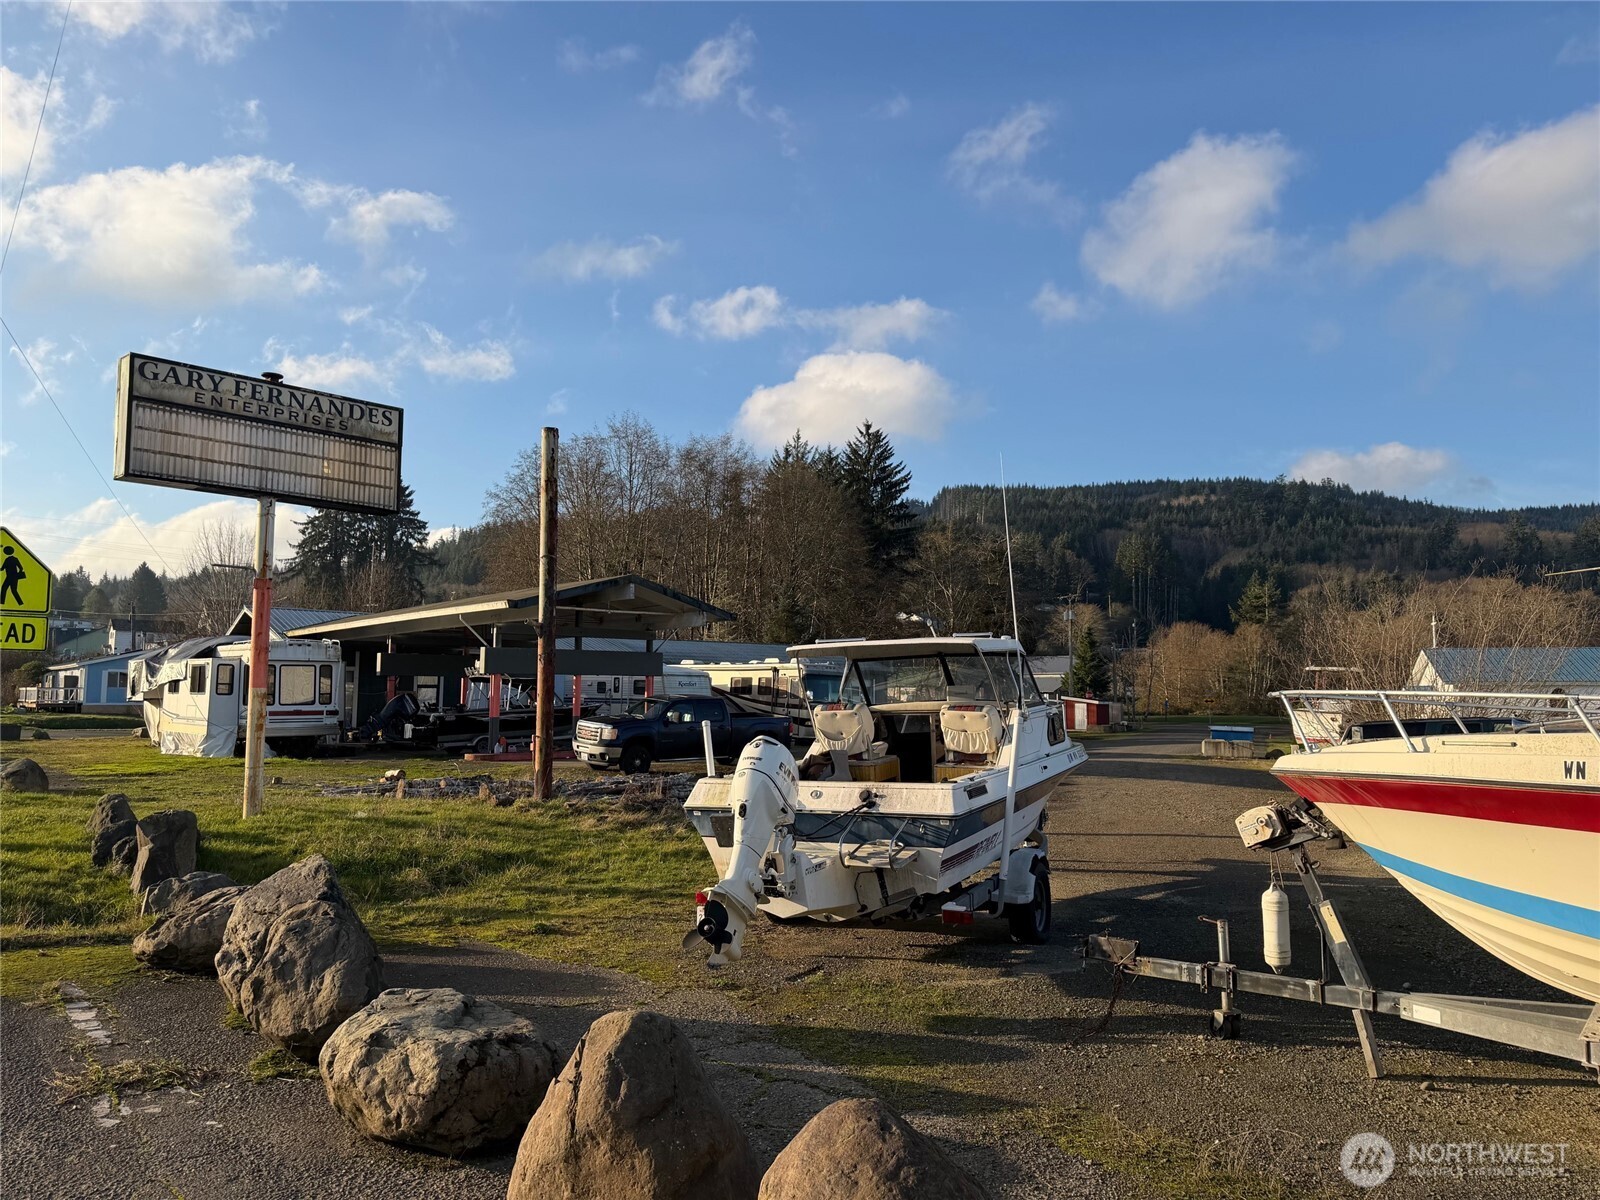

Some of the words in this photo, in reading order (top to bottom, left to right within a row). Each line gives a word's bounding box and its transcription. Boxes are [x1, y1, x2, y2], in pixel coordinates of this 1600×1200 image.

[138, 361, 226, 393] GARY
[232, 380, 393, 427] FERNANDES
[194, 392, 349, 431] ENTERPRISES
[0, 622, 36, 644] AD
[1563, 760, 1586, 780] WN
